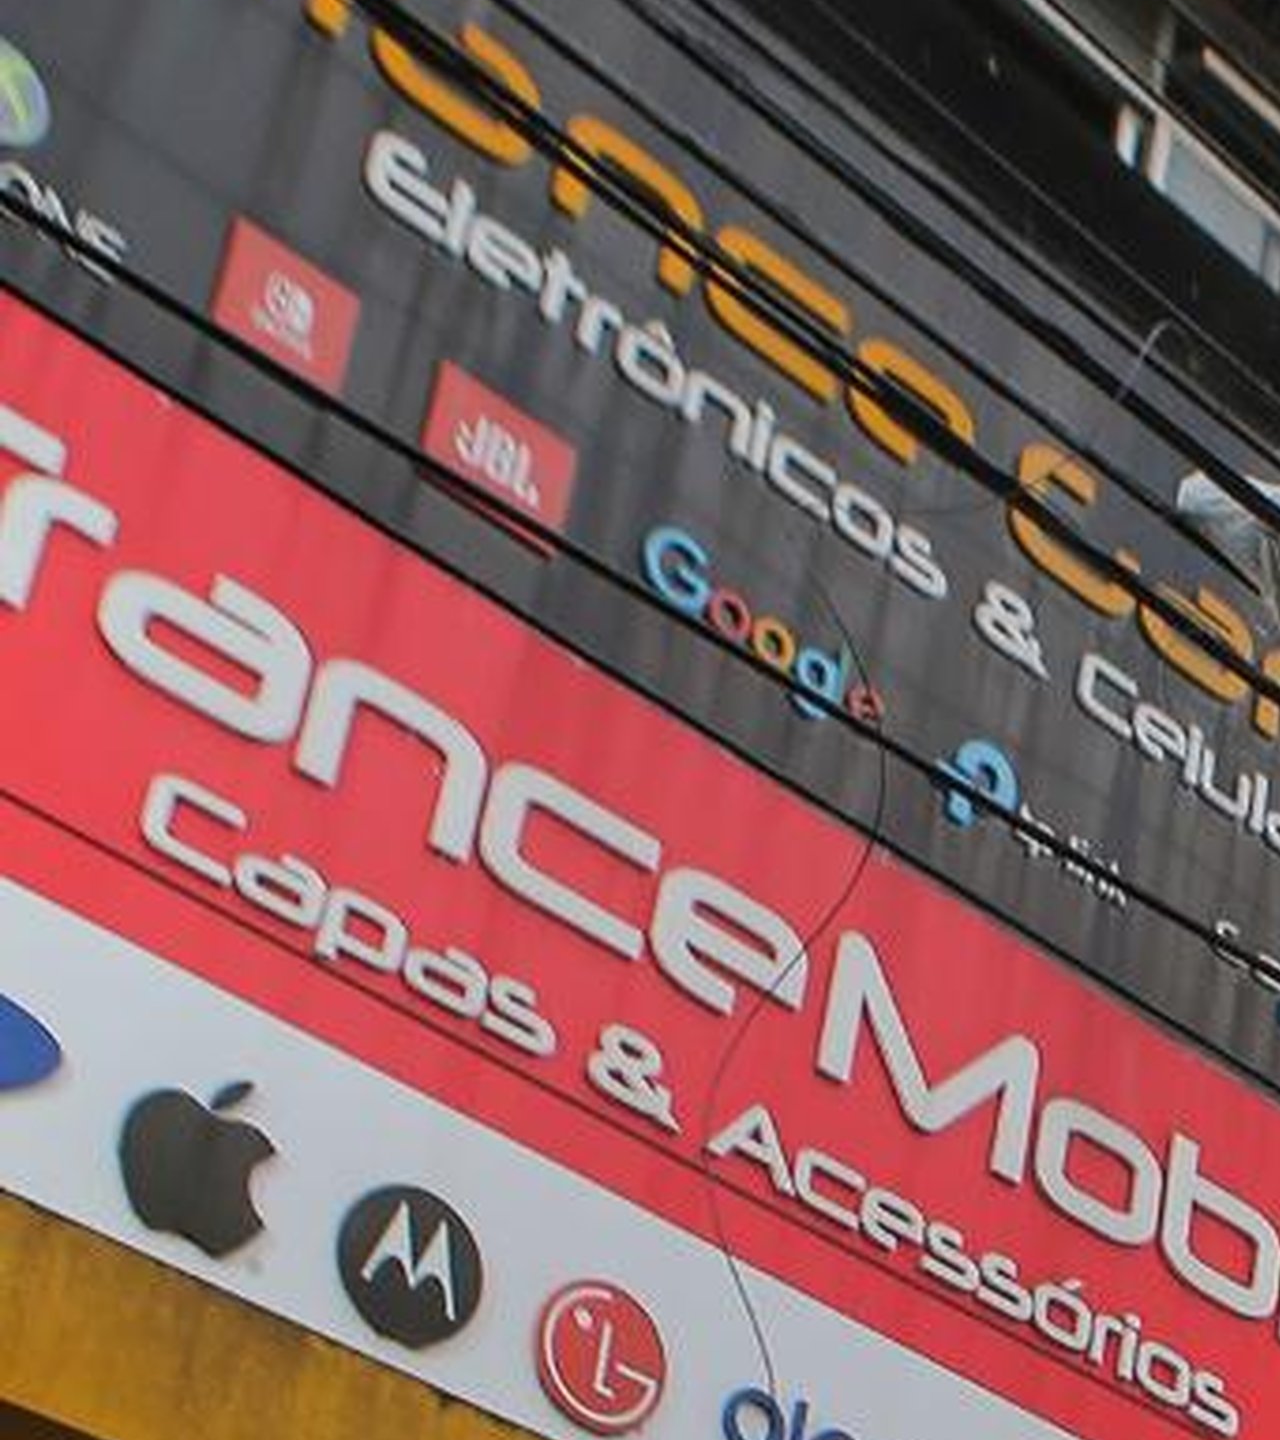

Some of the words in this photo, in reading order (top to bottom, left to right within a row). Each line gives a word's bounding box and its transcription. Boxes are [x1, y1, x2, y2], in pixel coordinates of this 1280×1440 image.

[364, 129, 950, 603] Eletrônicos
[972, 580, 1050, 682] &
[453, 414, 542, 510] JBL
[138, 772, 560, 1058] Capas
[586, 1022, 683, 1136] &
[703, 1103, 1242, 1438] Acessórios
